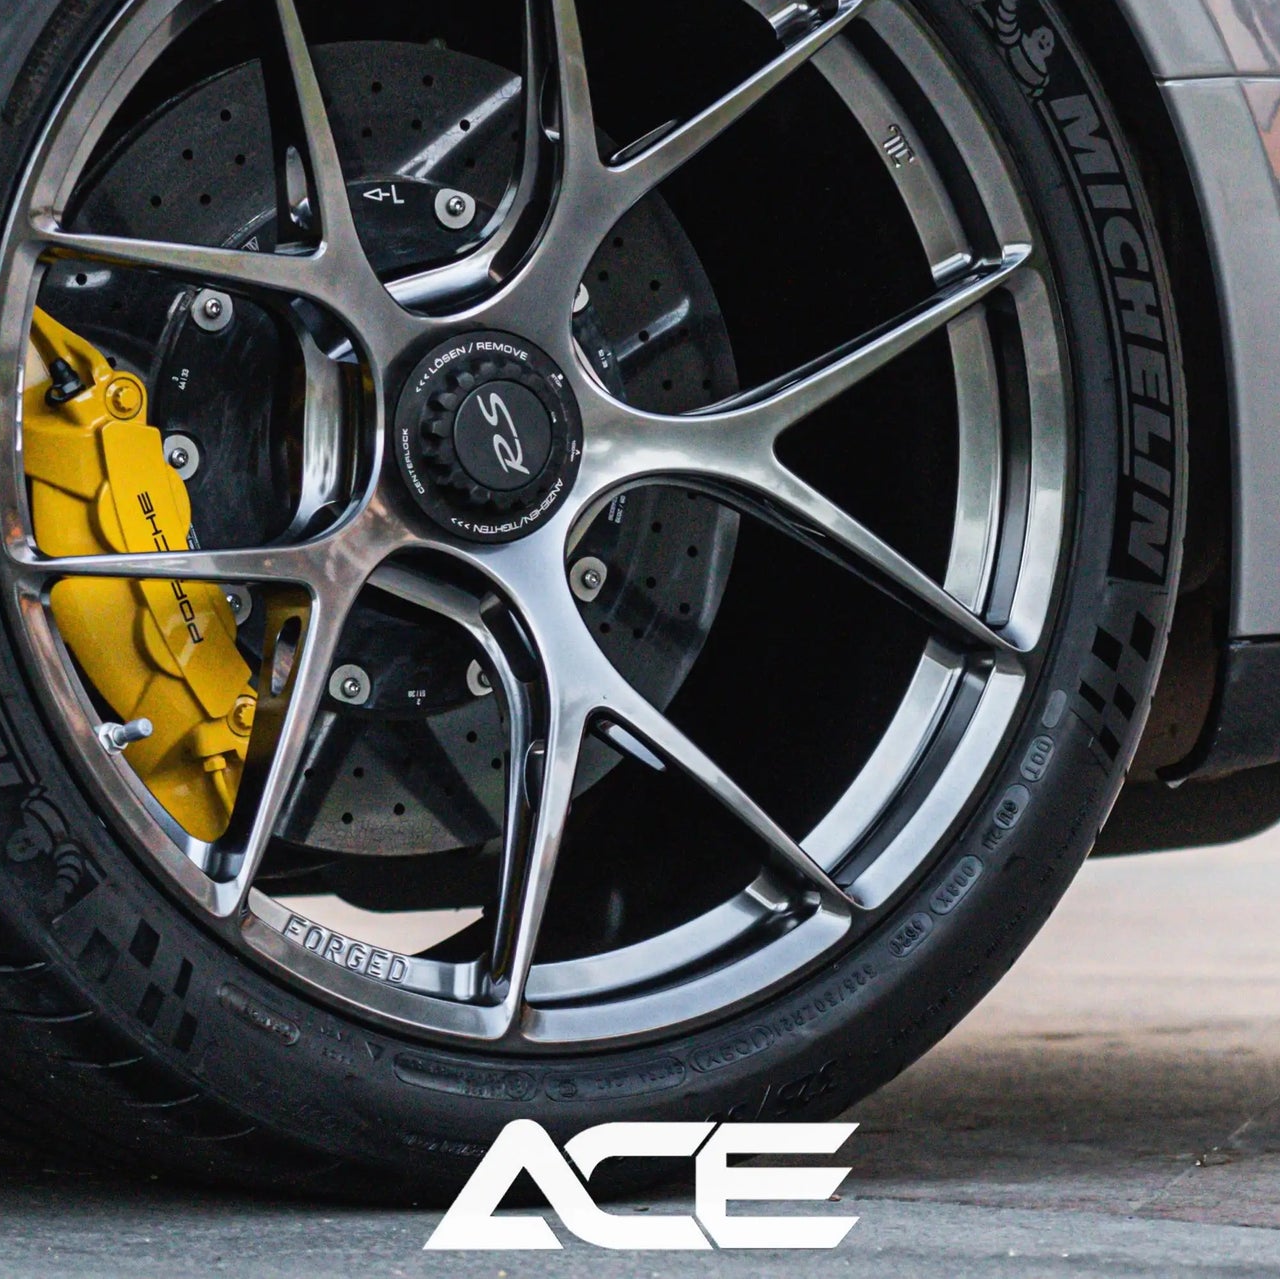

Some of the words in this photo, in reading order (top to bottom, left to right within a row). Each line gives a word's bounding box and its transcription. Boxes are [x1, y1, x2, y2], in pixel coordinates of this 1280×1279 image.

[429, 346, 466, 374] LÖSEN
[476, 341, 528, 362] REMOVE
[1050, 93, 1174, 577] MICHELIN
[402, 428, 426, 494] CENTERLOCK
[476, 392, 531, 476] RS
[137, 491, 204, 644] PORCHE
[1024, 739, 1052, 780] DOT
[281, 913, 410, 983] FORGED
